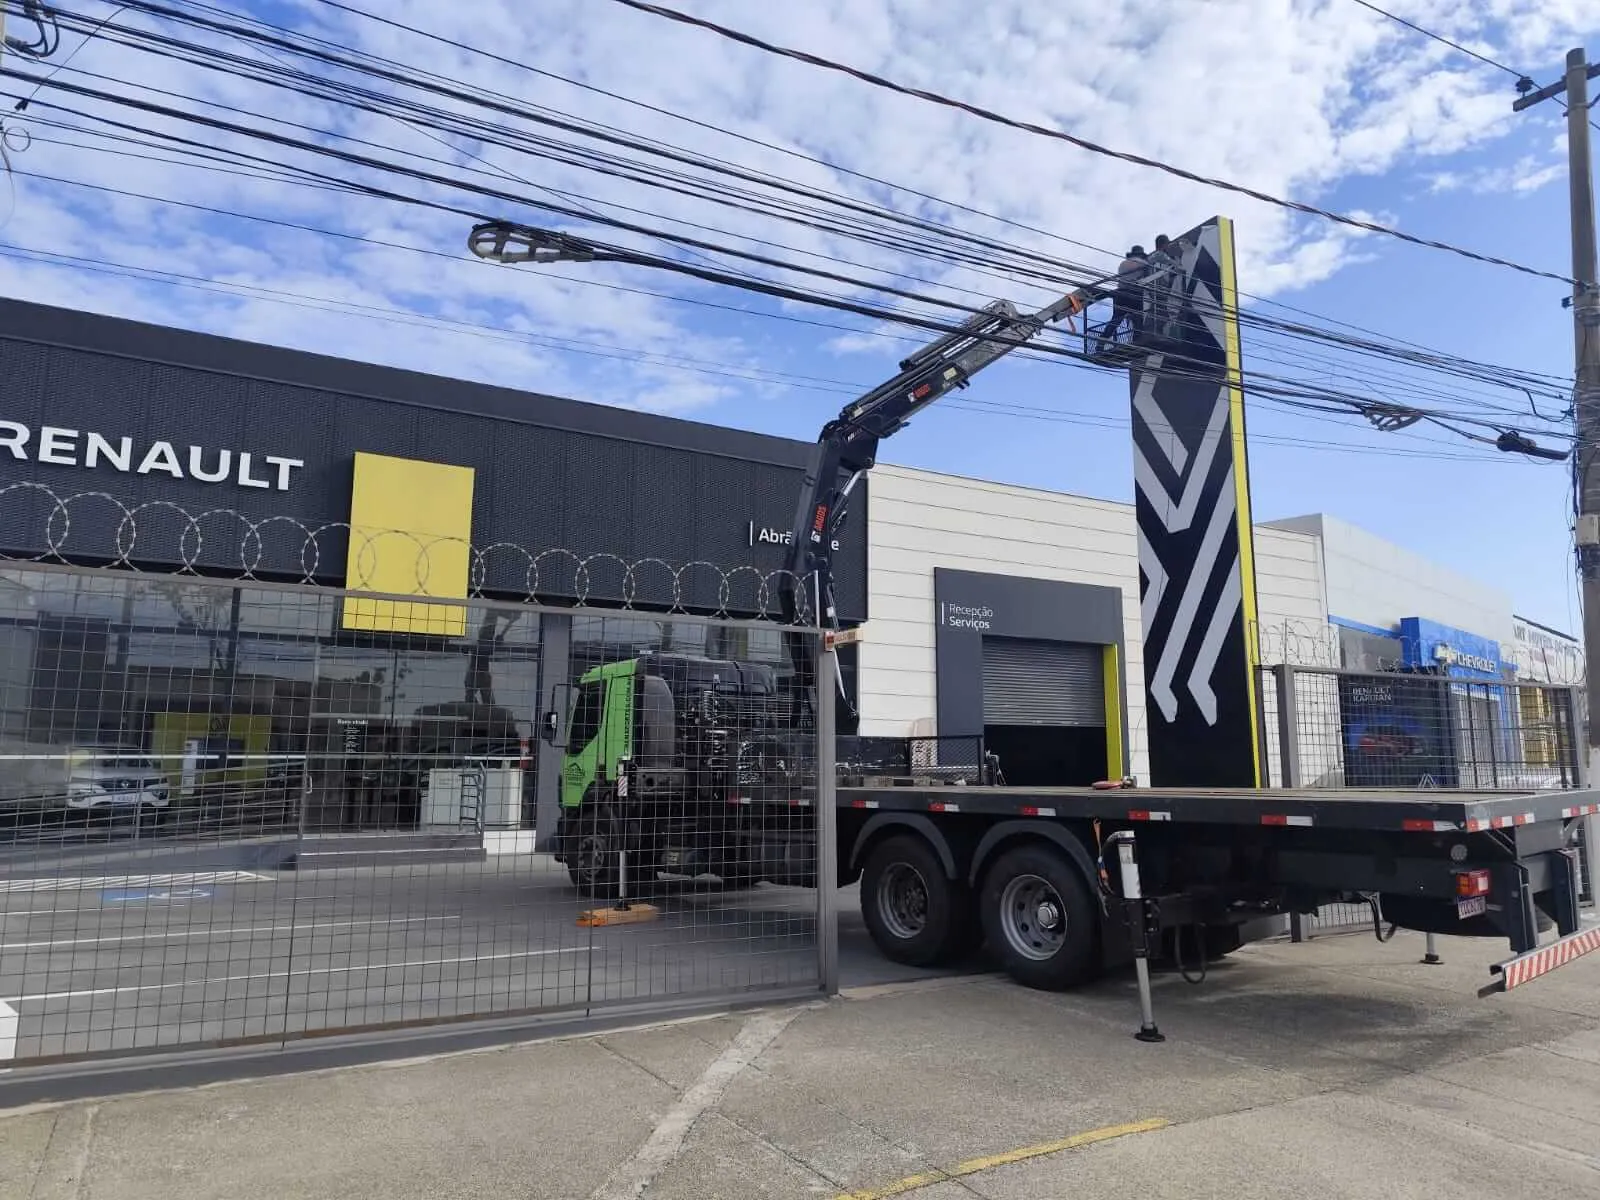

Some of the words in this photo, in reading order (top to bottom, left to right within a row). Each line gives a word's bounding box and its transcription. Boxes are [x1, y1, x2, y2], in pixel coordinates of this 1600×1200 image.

[0, 420, 304, 490] RENAULT
[758, 527, 795, 545] Abrã
[949, 603, 994, 619] Recepção
[949, 616, 991, 632] Serviços
[1457, 651, 1497, 674] CHEVROLET
